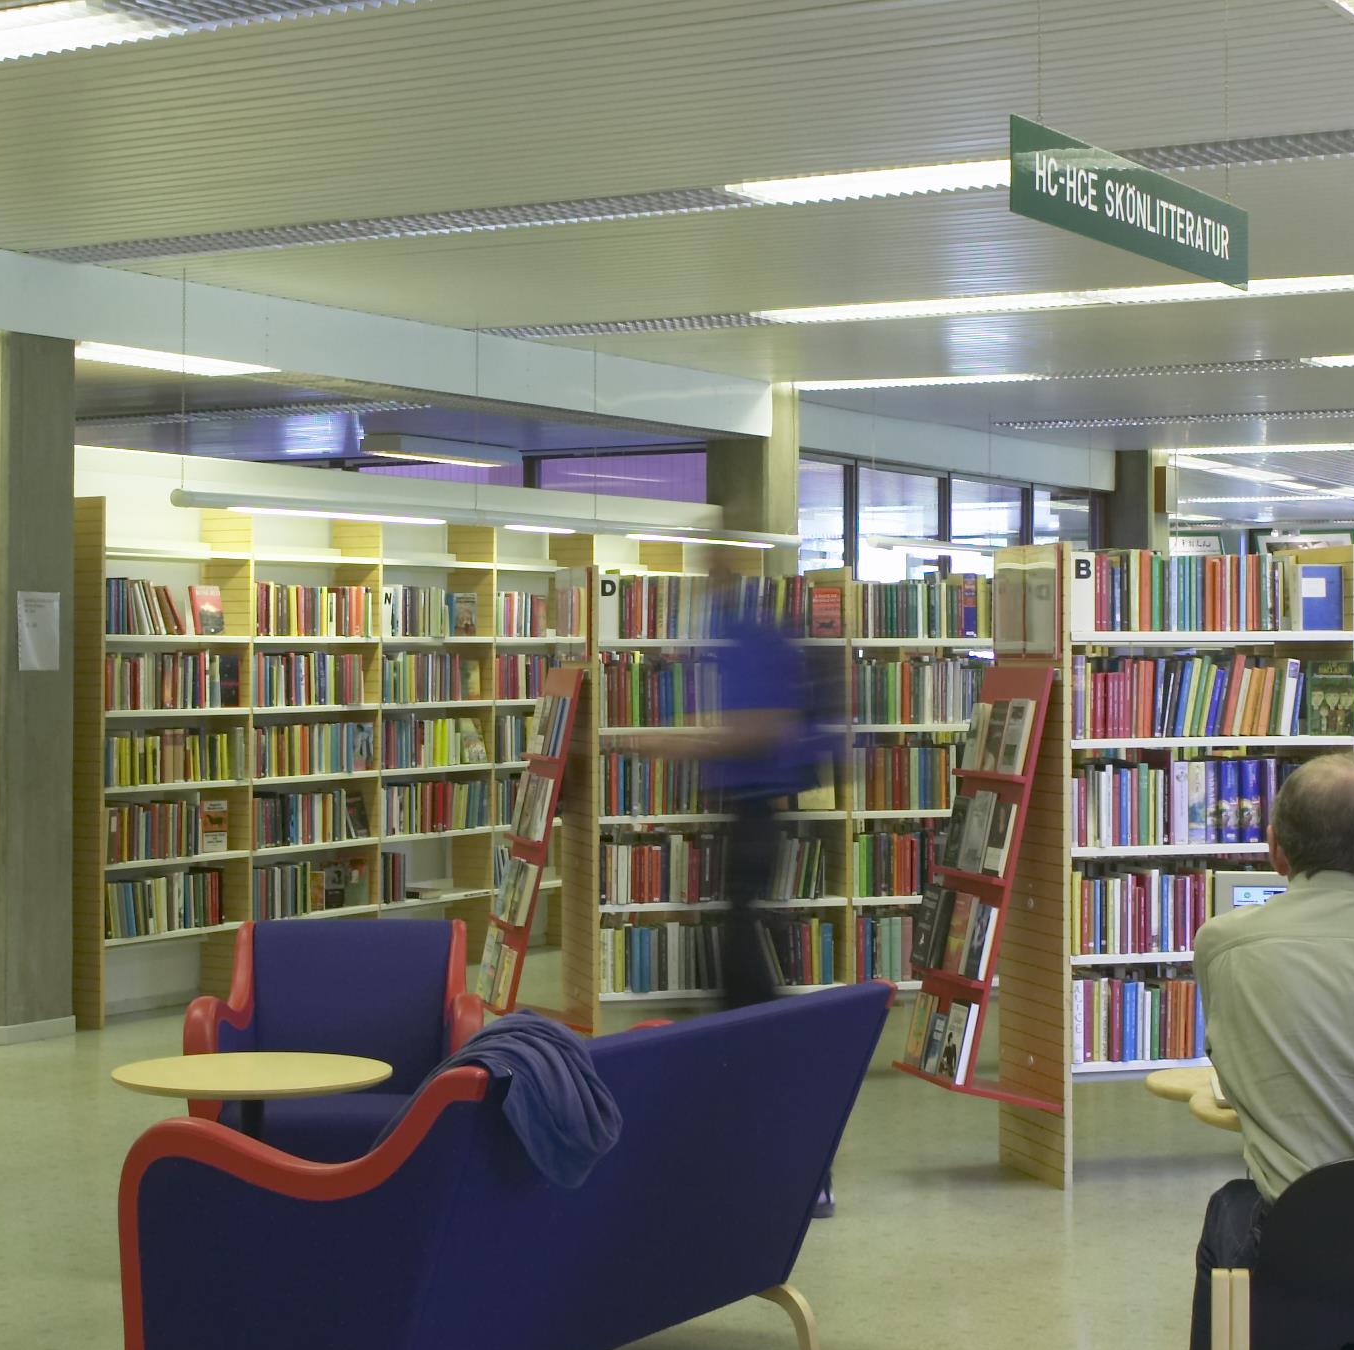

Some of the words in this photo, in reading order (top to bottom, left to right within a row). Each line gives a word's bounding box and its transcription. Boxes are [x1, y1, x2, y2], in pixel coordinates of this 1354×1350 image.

[1035, 152, 1098, 212] HC-HCE
[1104, 178, 1230, 260] SKÖNLITTERATUR
[1075, 558, 1091, 579] B
[601, 579, 616, 597] D
